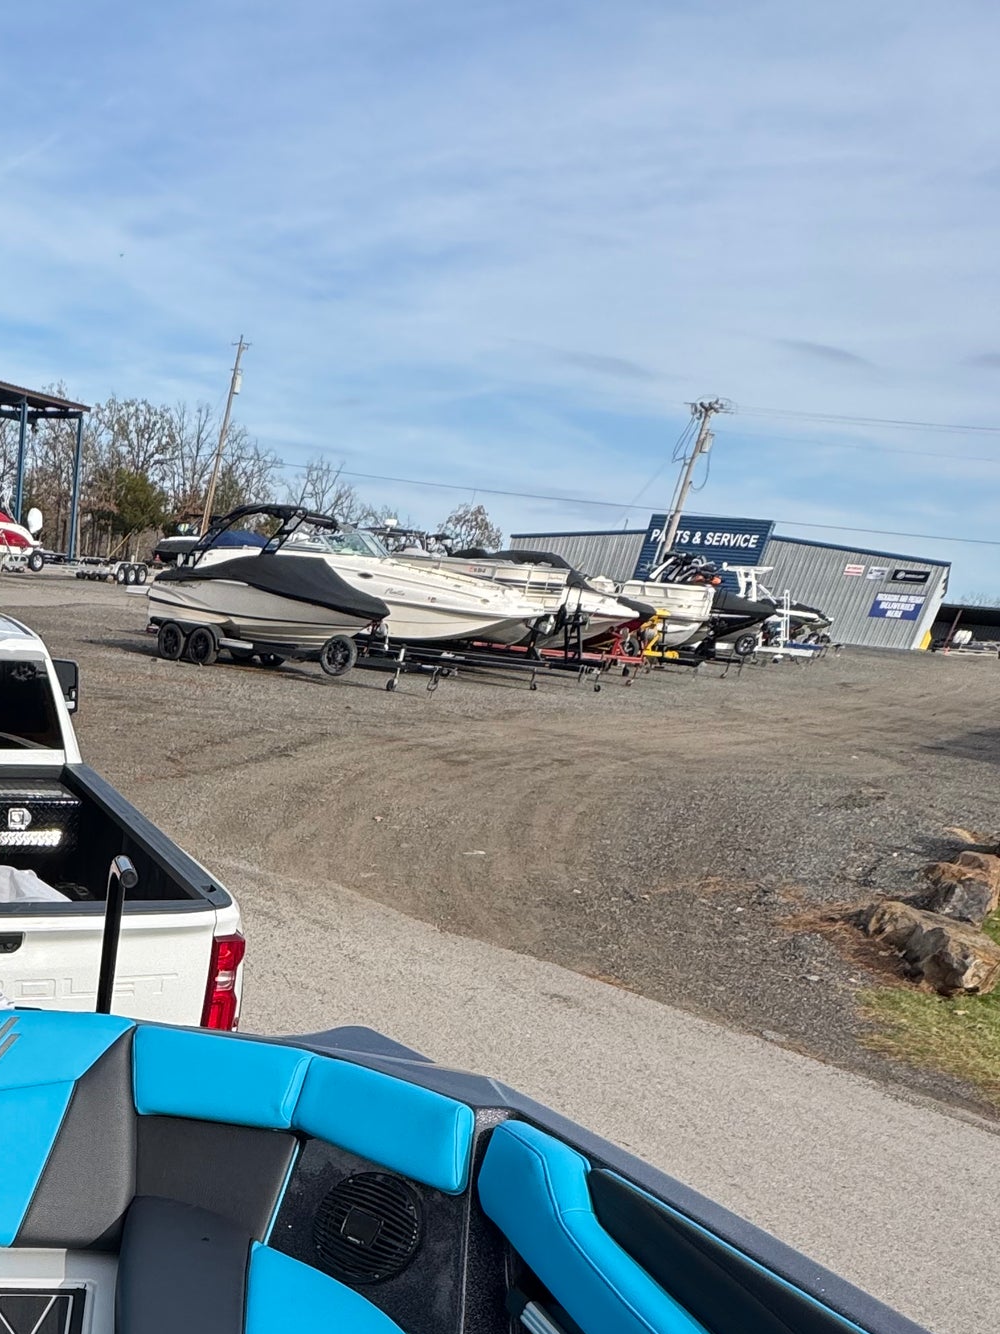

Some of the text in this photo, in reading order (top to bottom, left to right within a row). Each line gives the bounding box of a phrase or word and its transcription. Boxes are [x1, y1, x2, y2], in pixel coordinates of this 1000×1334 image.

[650, 529, 760, 548] PATS & SERVICE
